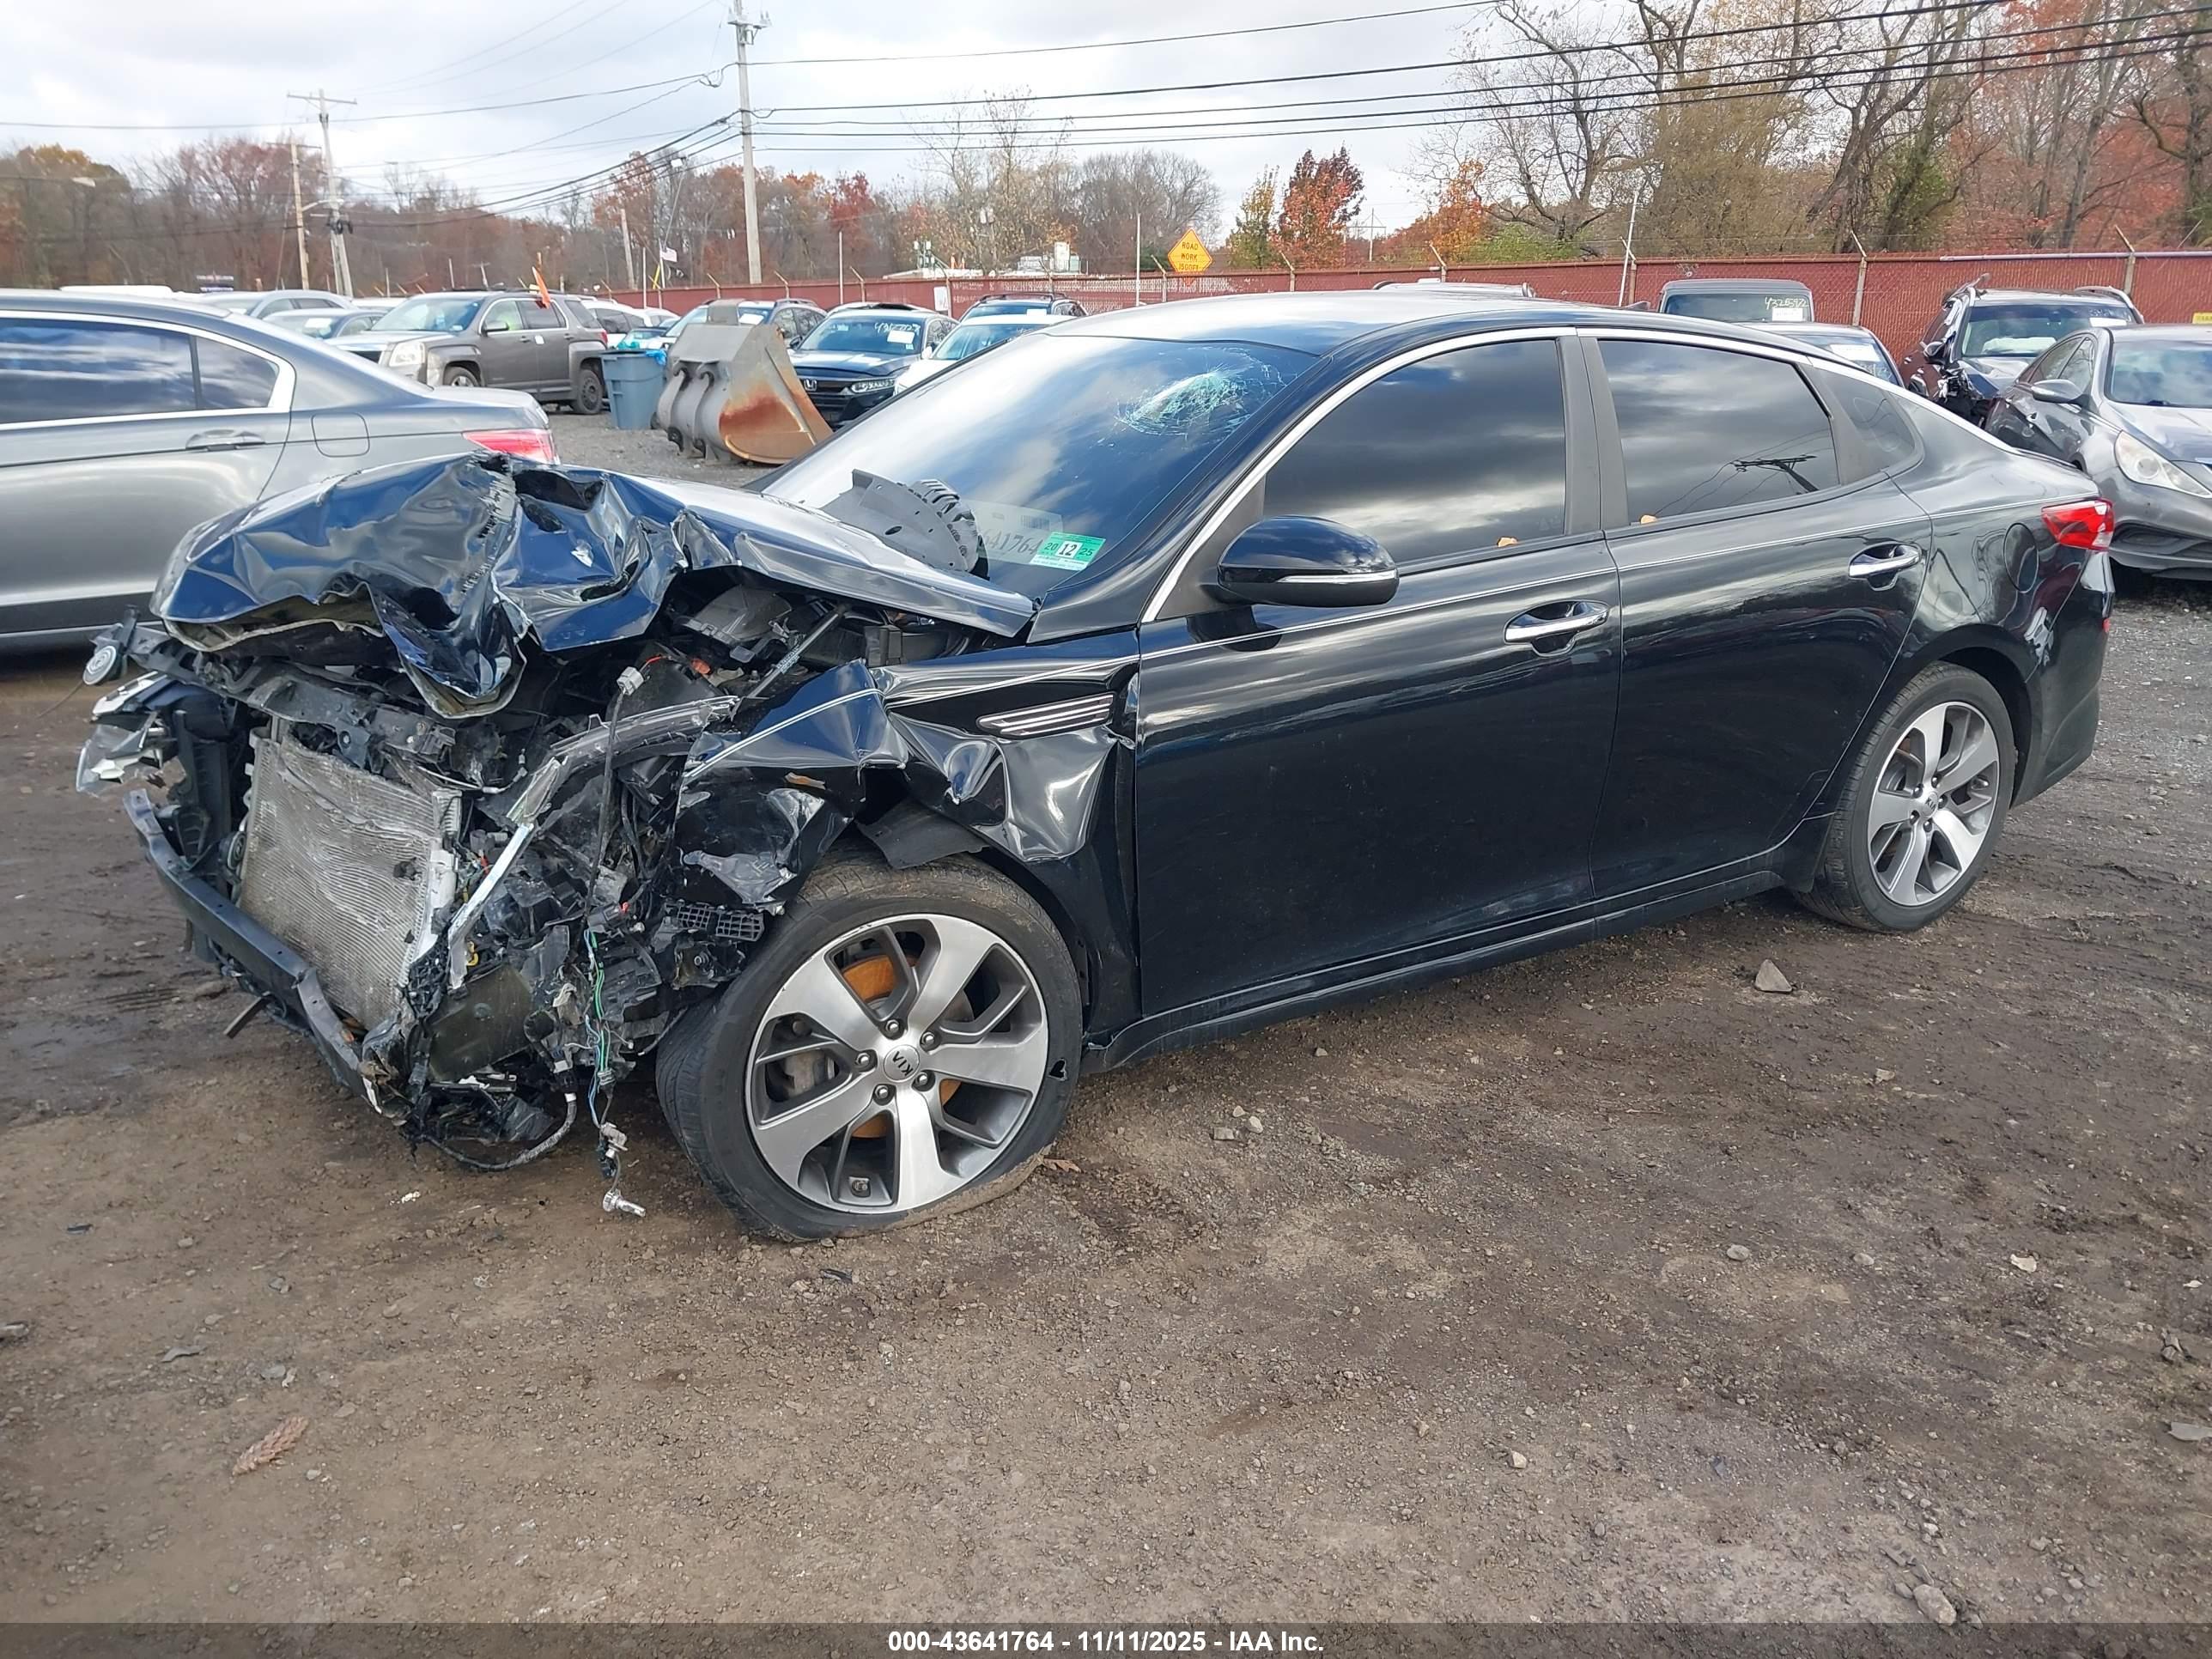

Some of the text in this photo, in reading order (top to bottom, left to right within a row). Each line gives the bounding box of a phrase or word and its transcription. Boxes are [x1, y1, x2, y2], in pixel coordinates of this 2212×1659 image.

[1182, 241, 1199, 251] ROAD
[1181, 252, 1198, 262] WORK
[1045, 542, 1094, 556] 20 12 25
[1924, 797, 1937, 811] KIA
[892, 1050, 914, 1077] KIA
